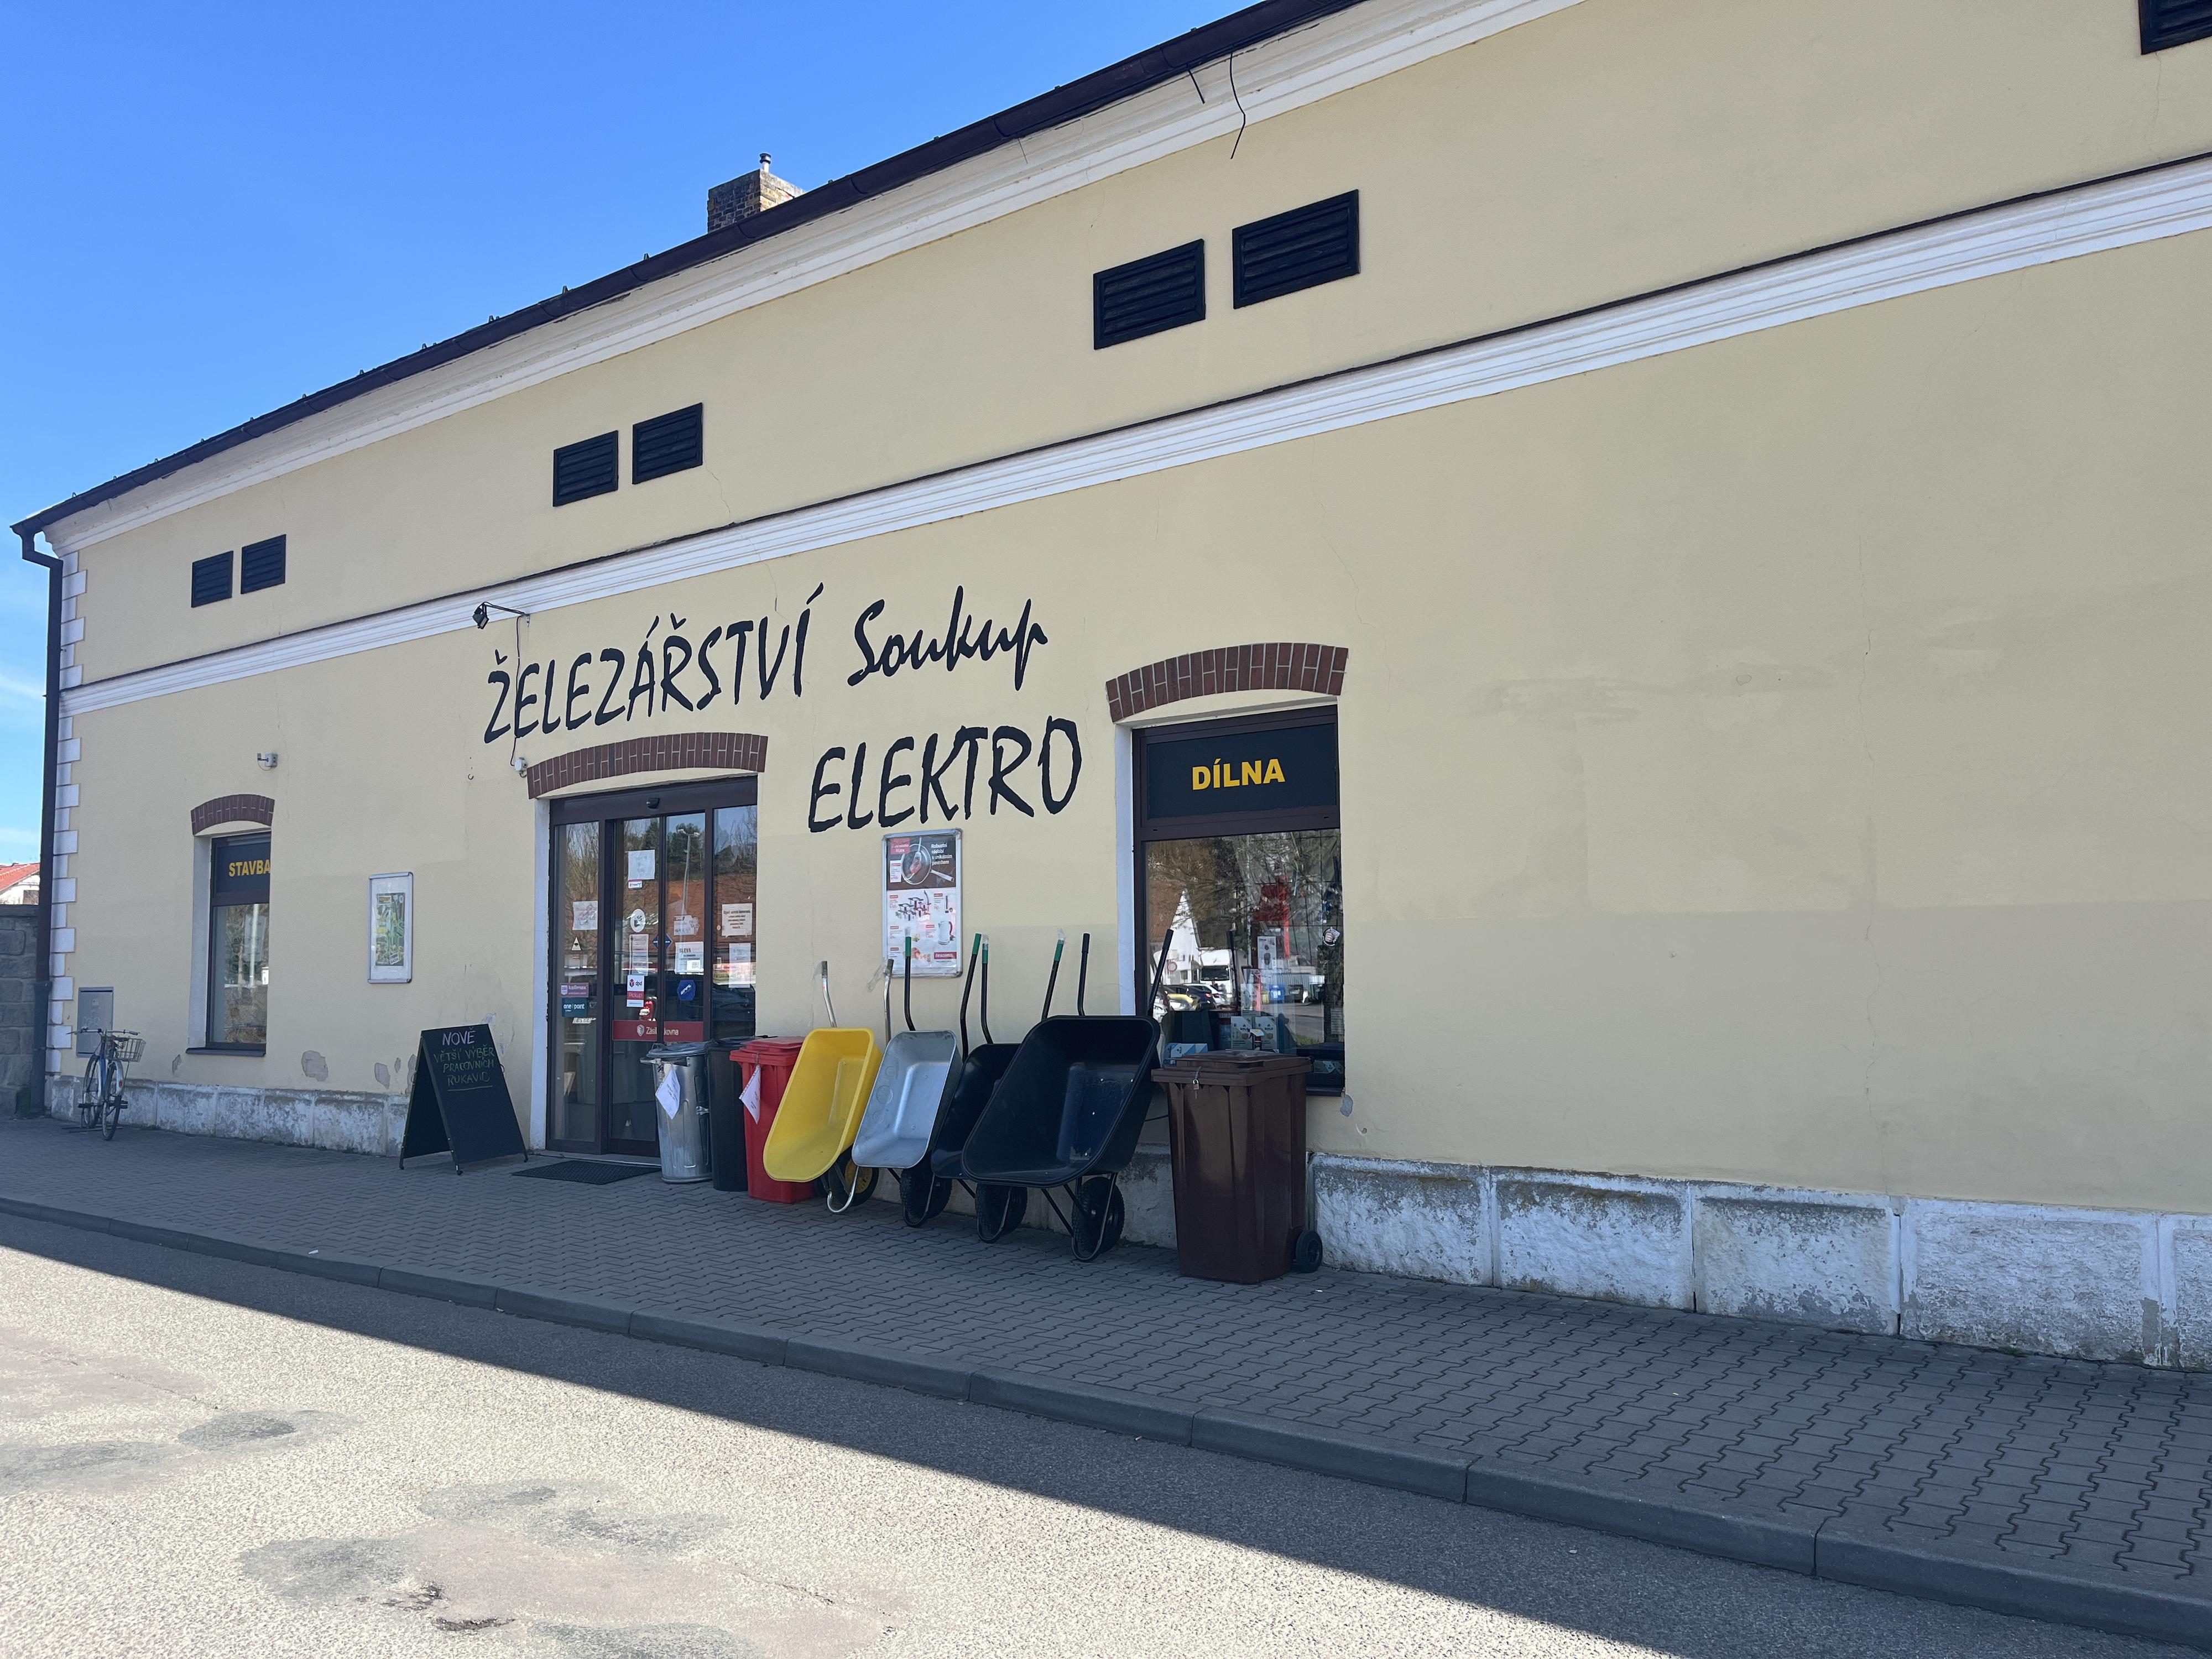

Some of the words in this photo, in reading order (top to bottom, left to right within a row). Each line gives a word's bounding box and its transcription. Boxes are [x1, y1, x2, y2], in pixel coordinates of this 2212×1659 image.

[484, 582, 824, 744] ŽELEZÁŘSTVÍ
[847, 585, 1048, 691] Soukup
[808, 716, 1082, 833] ELEKTRO
[1192, 758, 1286, 791] DÍLNA
[229, 859, 270, 877] STAVBA
[434, 1048, 462, 1063] VĚTŠÍ
[465, 1044, 495, 1059] VÝBĚR
[443, 1056, 494, 1073] PRACOVNÍCH
[447, 1072, 491, 1087] RUKAVIC
